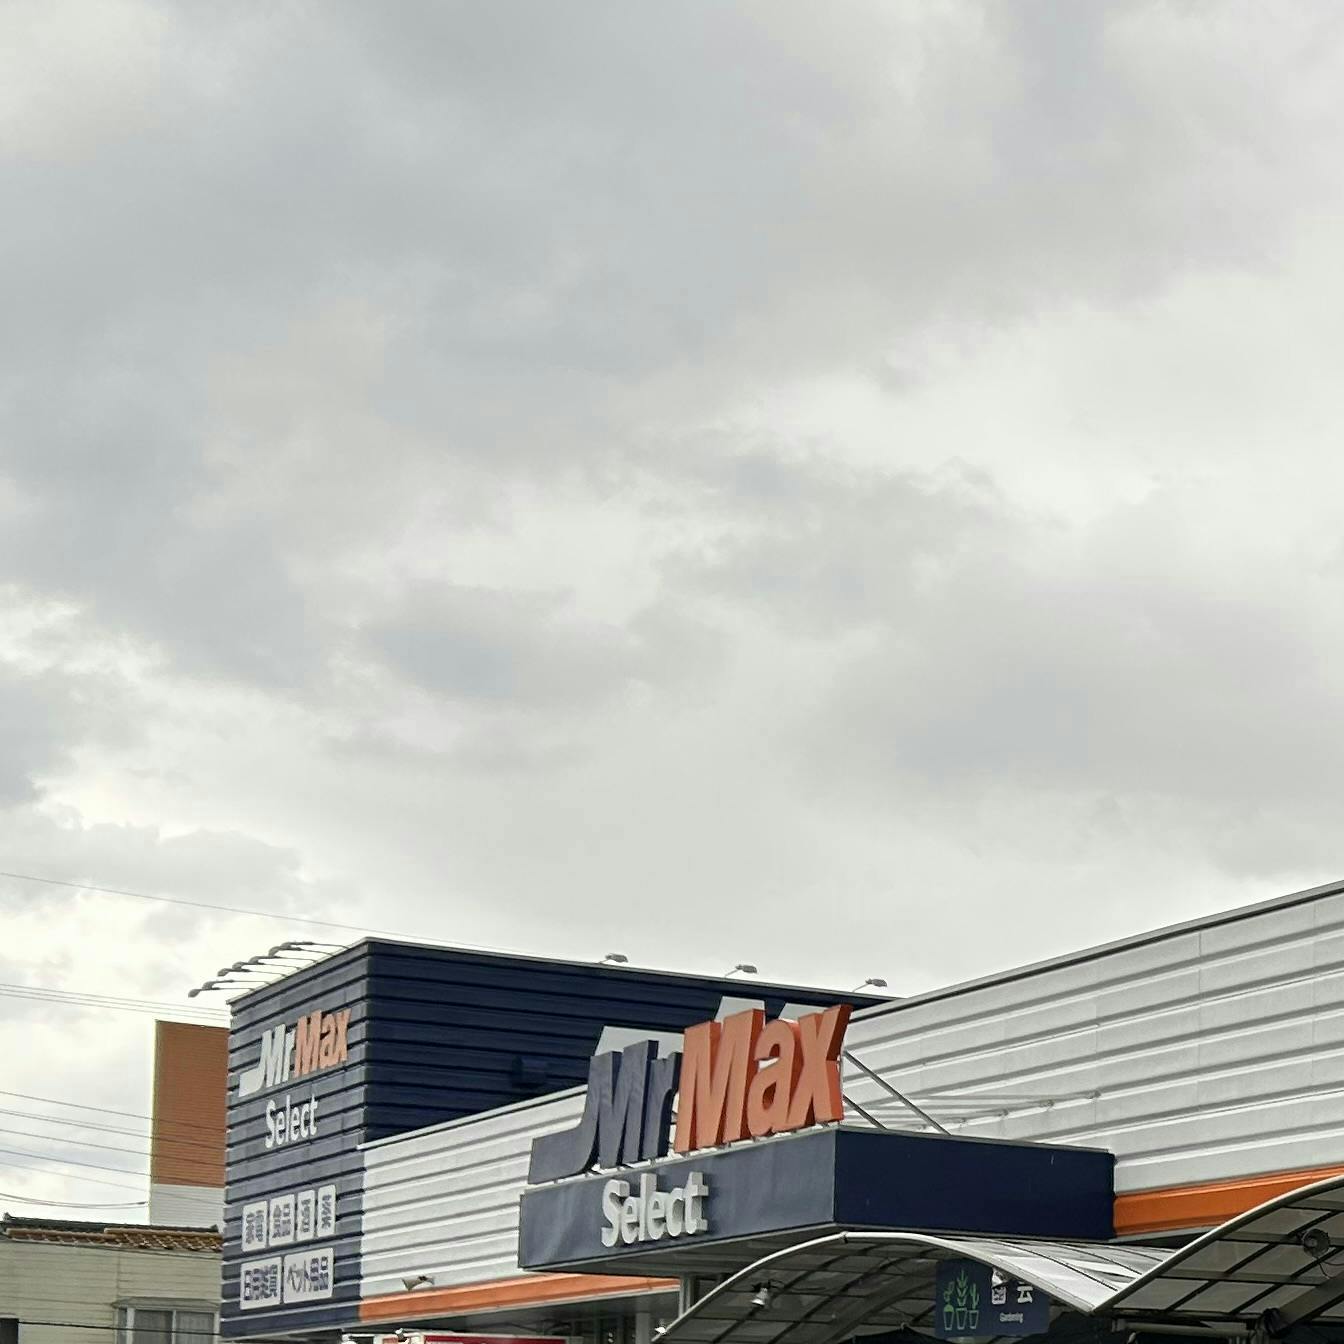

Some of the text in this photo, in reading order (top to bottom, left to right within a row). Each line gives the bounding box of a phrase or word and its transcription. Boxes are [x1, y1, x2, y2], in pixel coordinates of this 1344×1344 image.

[238, 1008, 352, 1098] MrMax
[264, 1093, 319, 1149] Select
[529, 1004, 854, 1186] MrMax
[601, 1171, 710, 1248] Select
